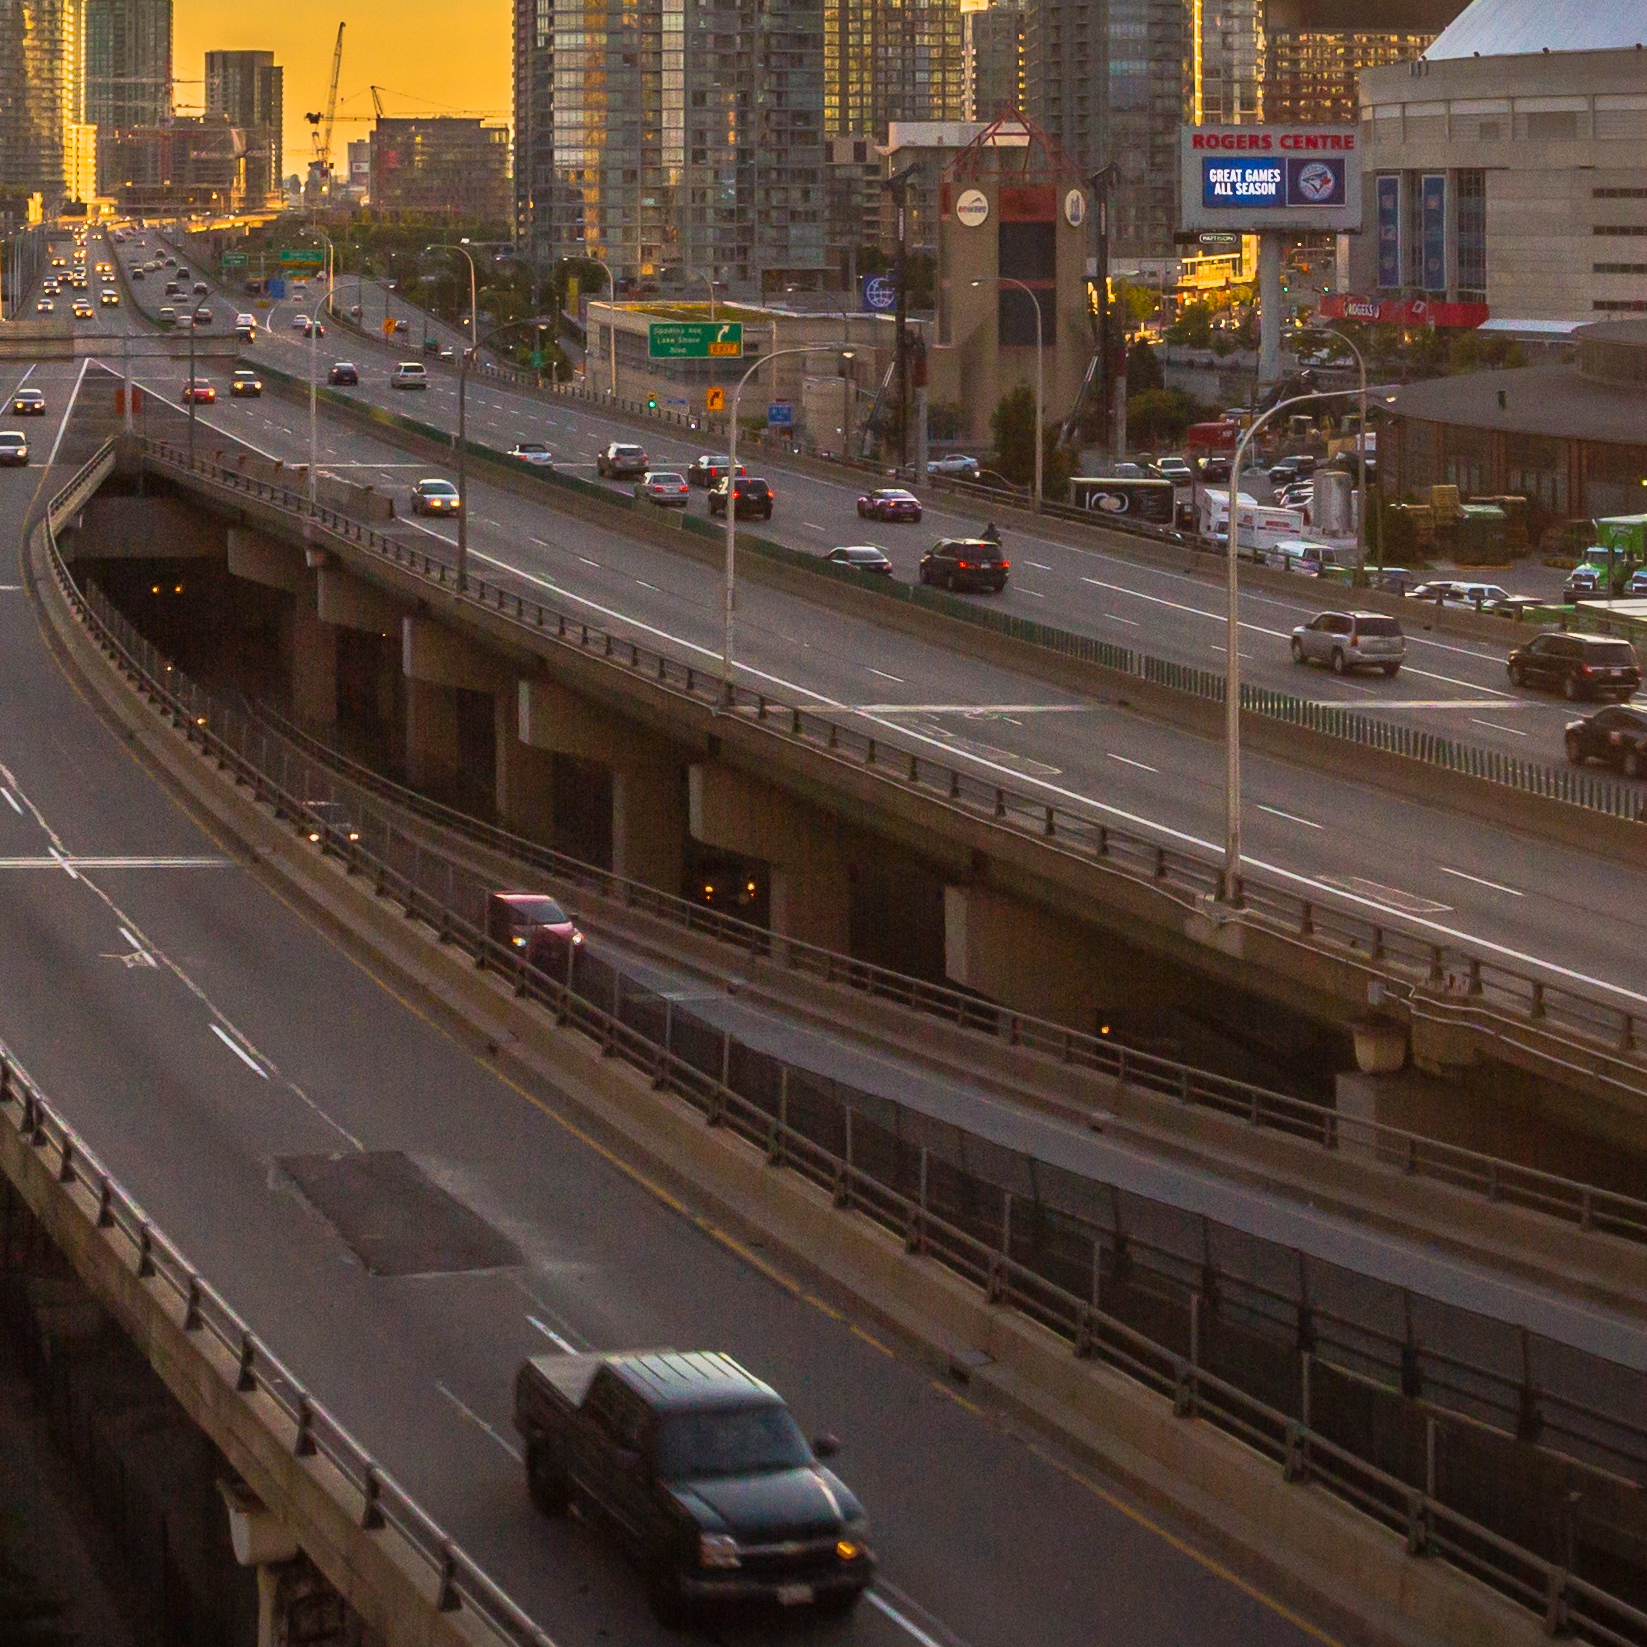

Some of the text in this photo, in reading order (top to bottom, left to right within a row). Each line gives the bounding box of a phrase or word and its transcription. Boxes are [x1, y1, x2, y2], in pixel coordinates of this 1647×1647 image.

[1192, 134, 1355, 150] ROGERS CENTRE
[1209, 168, 1281, 183] GREAT GAMES
[1214, 182, 1276, 195] ALL SEASON
